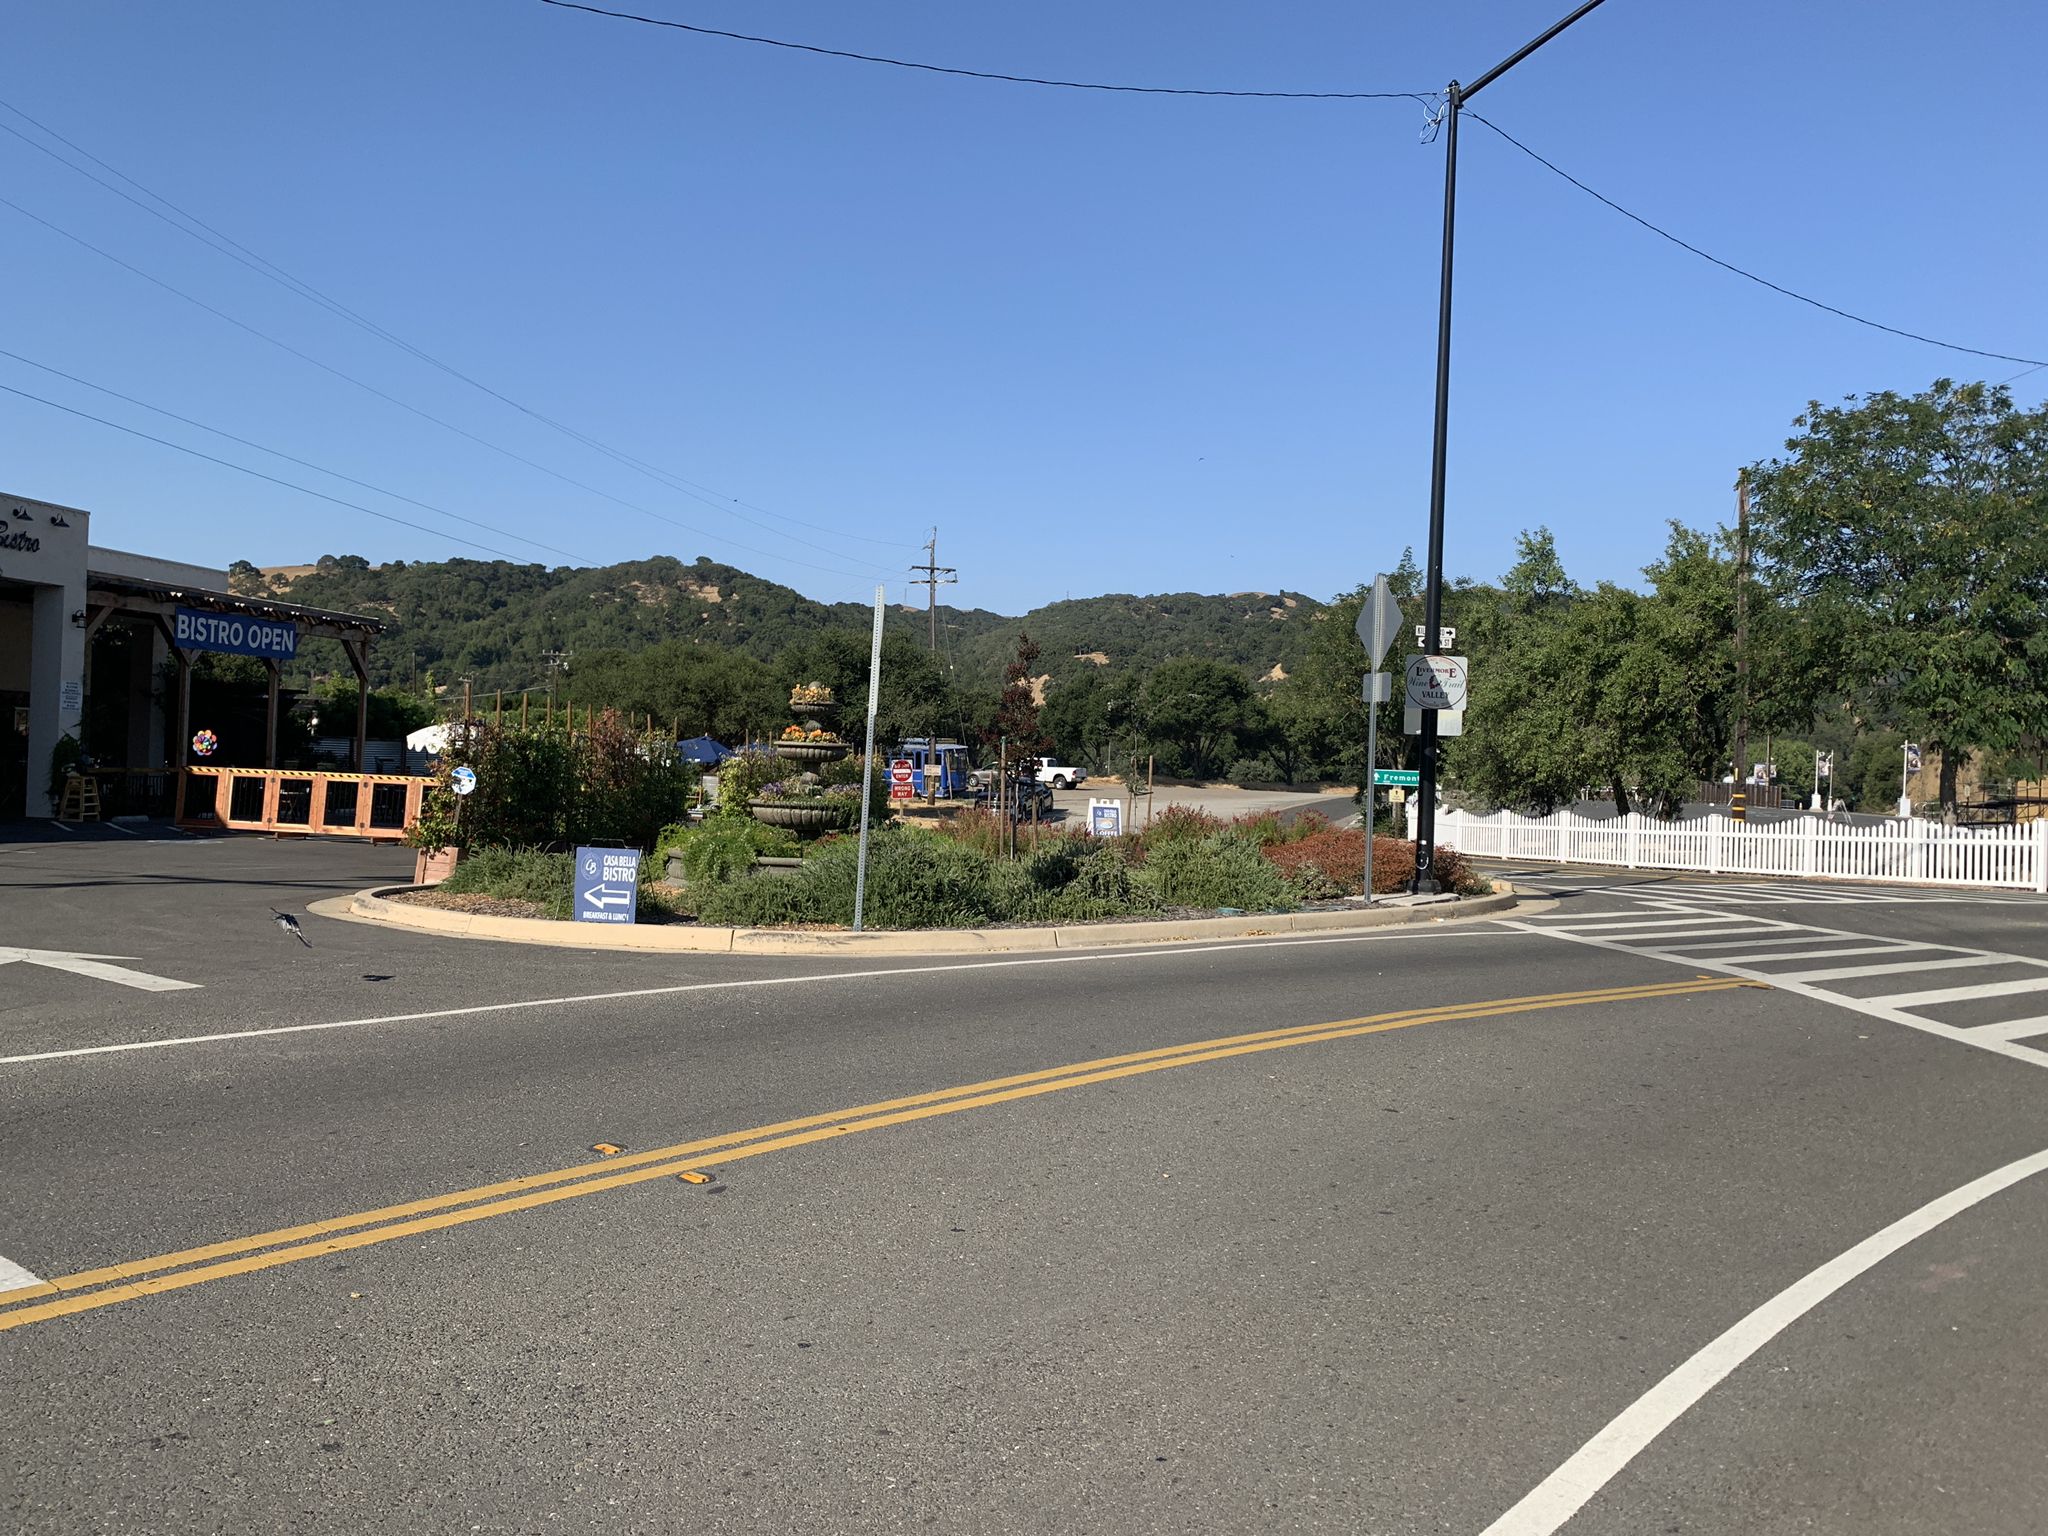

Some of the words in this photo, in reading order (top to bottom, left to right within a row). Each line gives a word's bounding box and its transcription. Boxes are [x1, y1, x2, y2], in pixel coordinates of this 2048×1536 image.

[177, 614, 243, 646] BISTRO
[247, 624, 294, 652] OPEN
[1422, 691, 1449, 699] VALLEY
[603, 854, 619, 866] CASA
[619, 855, 636, 868] BELLA
[603, 867, 636, 883] BISTRO
[583, 911, 608, 920] BREAKFAST
